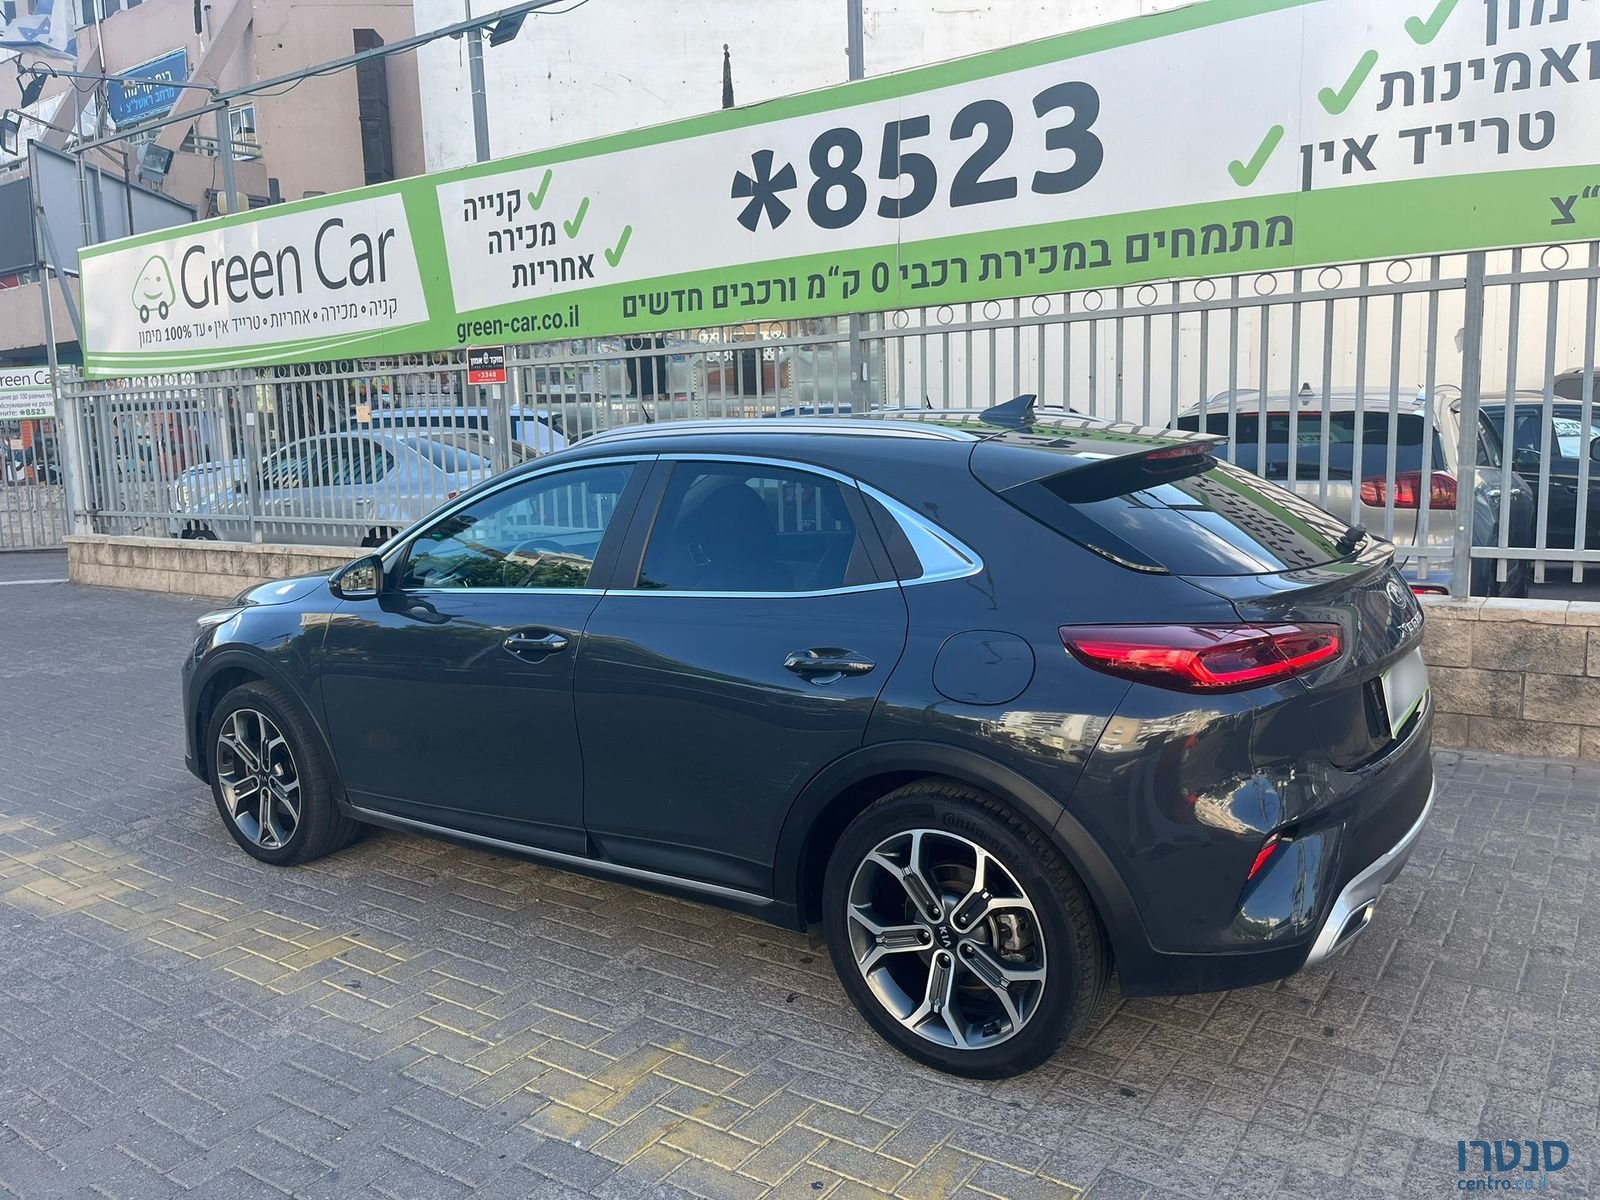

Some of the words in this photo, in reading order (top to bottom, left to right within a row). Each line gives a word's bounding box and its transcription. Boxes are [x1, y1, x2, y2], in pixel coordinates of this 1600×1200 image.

[155, 88, 174, 102] מרחב
[1398, 110, 1556, 165] טרייד
[1299, 133, 1379, 192] אין
[463, 189, 521, 222] קנייה
[488, 221, 556, 255] מכירה
[1126, 215, 1294, 264] מתמחים
[180, 244, 303, 310] Green
[314, 217, 396, 290] Car
[511, 254, 595, 289] אחריות
[898, 256, 969, 290] רכבי
[979, 239, 1112, 282] במכירת
[369, 297, 399, 320] קניה
[622, 287, 703, 319] חדשים
[712, 276, 797, 309] ורכבים
[231, 315, 261, 334] טרייד
[269, 308, 311, 330] אחריות
[321, 302, 358, 323] מכירה
[456, 304, 581, 343] green-car.co.il
[138, 330, 163, 349] מימון
[164, 325, 192, 342] 100%
[193, 323, 207, 339] עד
[213, 318, 230, 340] אין
[0, 375, 31, 387] reen
[34, 370, 52, 385] Ca
[938, 926, 952, 948] KIA
